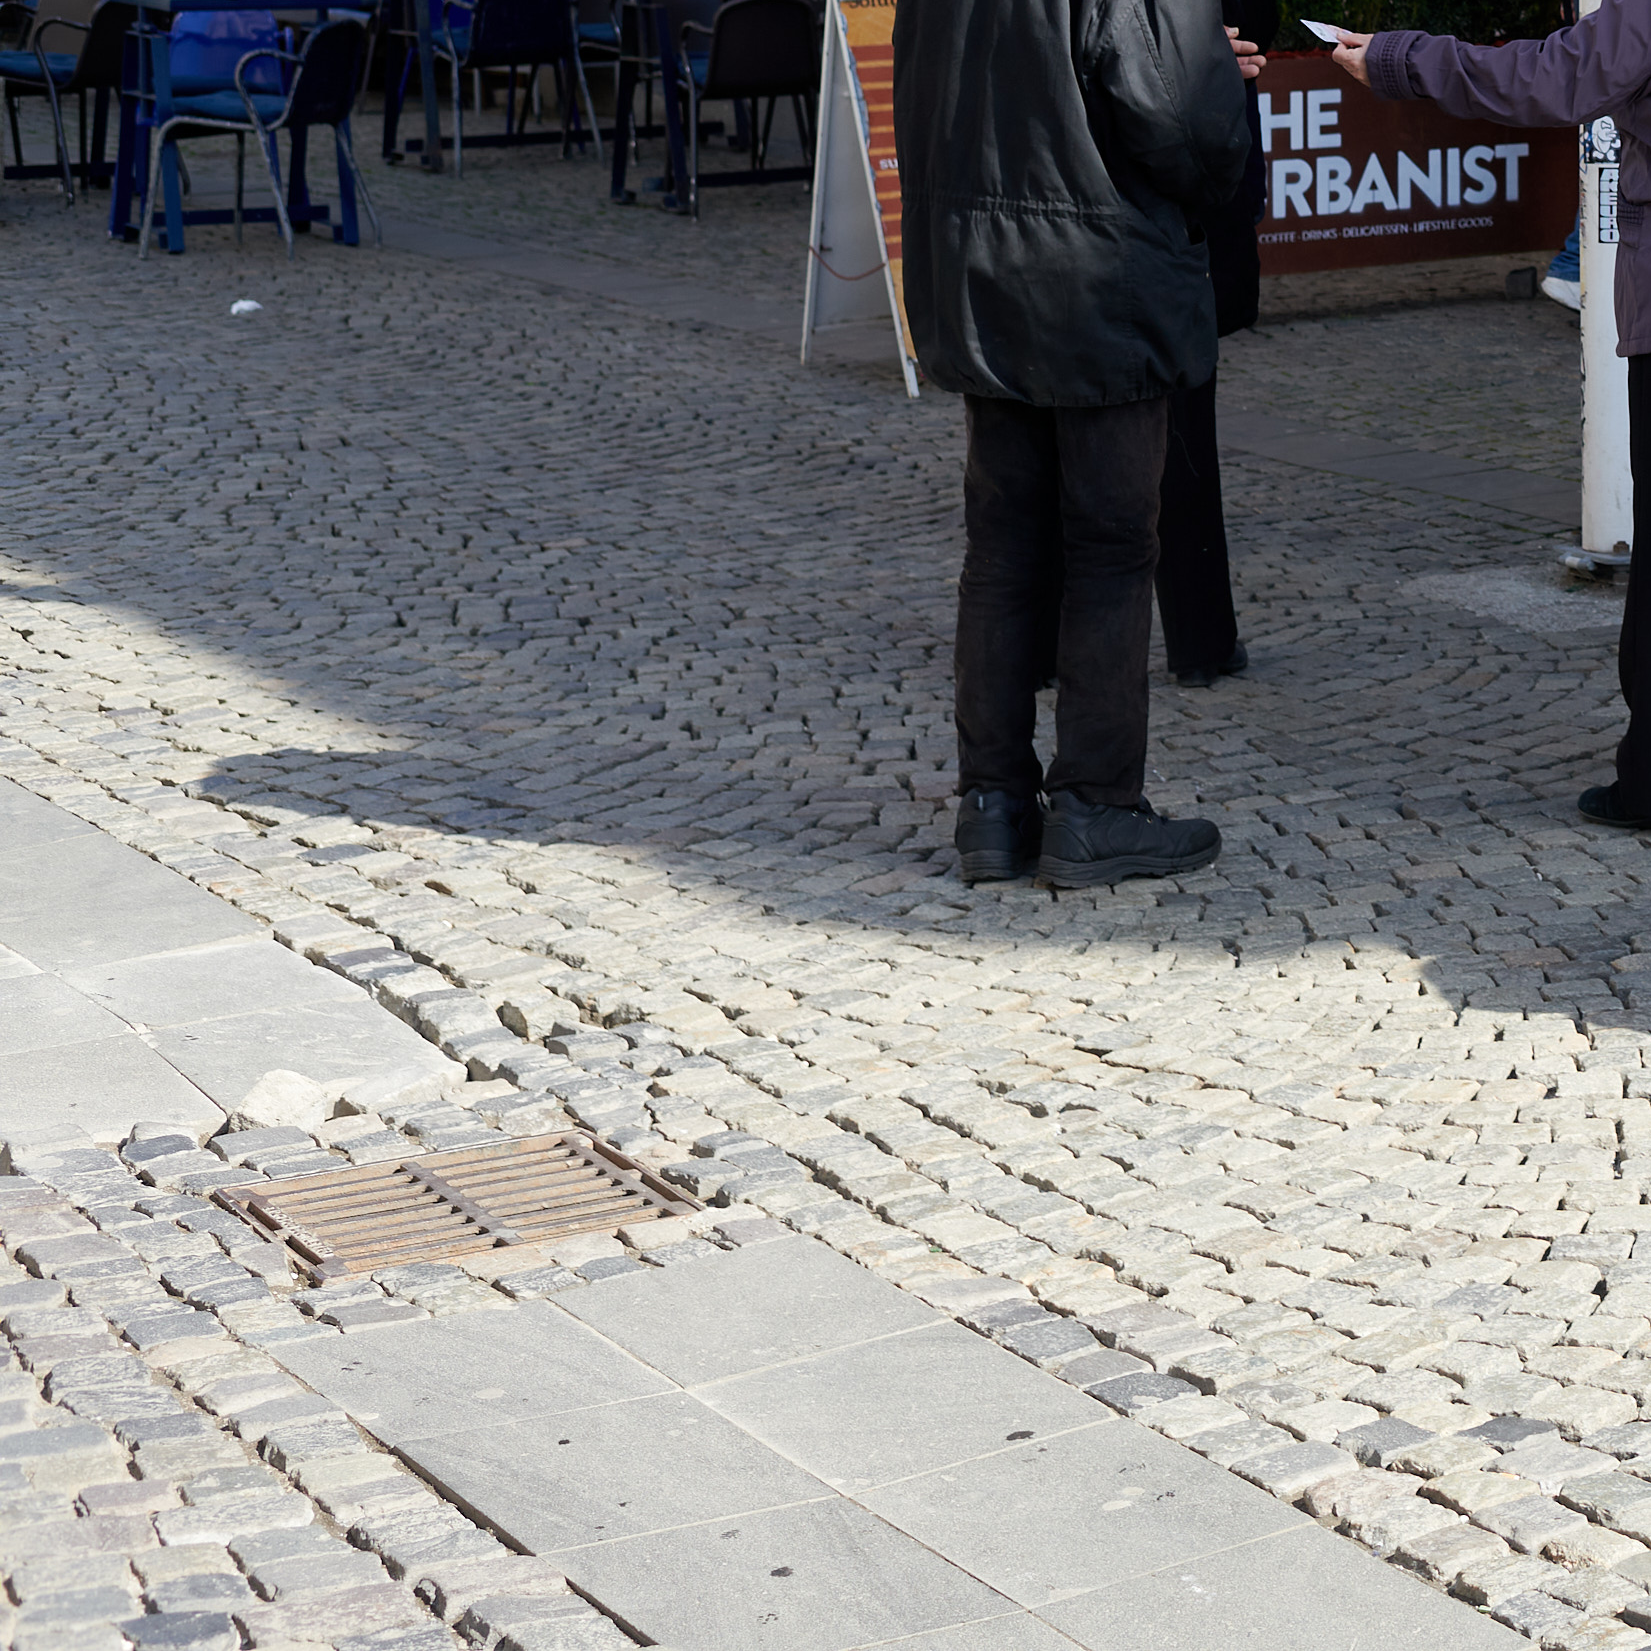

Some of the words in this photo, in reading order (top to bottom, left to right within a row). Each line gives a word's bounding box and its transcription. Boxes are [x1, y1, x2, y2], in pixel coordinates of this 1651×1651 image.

[1258, 88, 1342, 153] HE
[1265, 143, 1529, 219] RBANIST
[1259, 229, 1297, 244] COFFEE
[1302, 228, 1338, 242] DRINKS
[1343, 222, 1409, 239] DELICATESSEN
[1413, 218, 1456, 234] LIFESTYLE
[1458, 216, 1494, 230] GOODS
